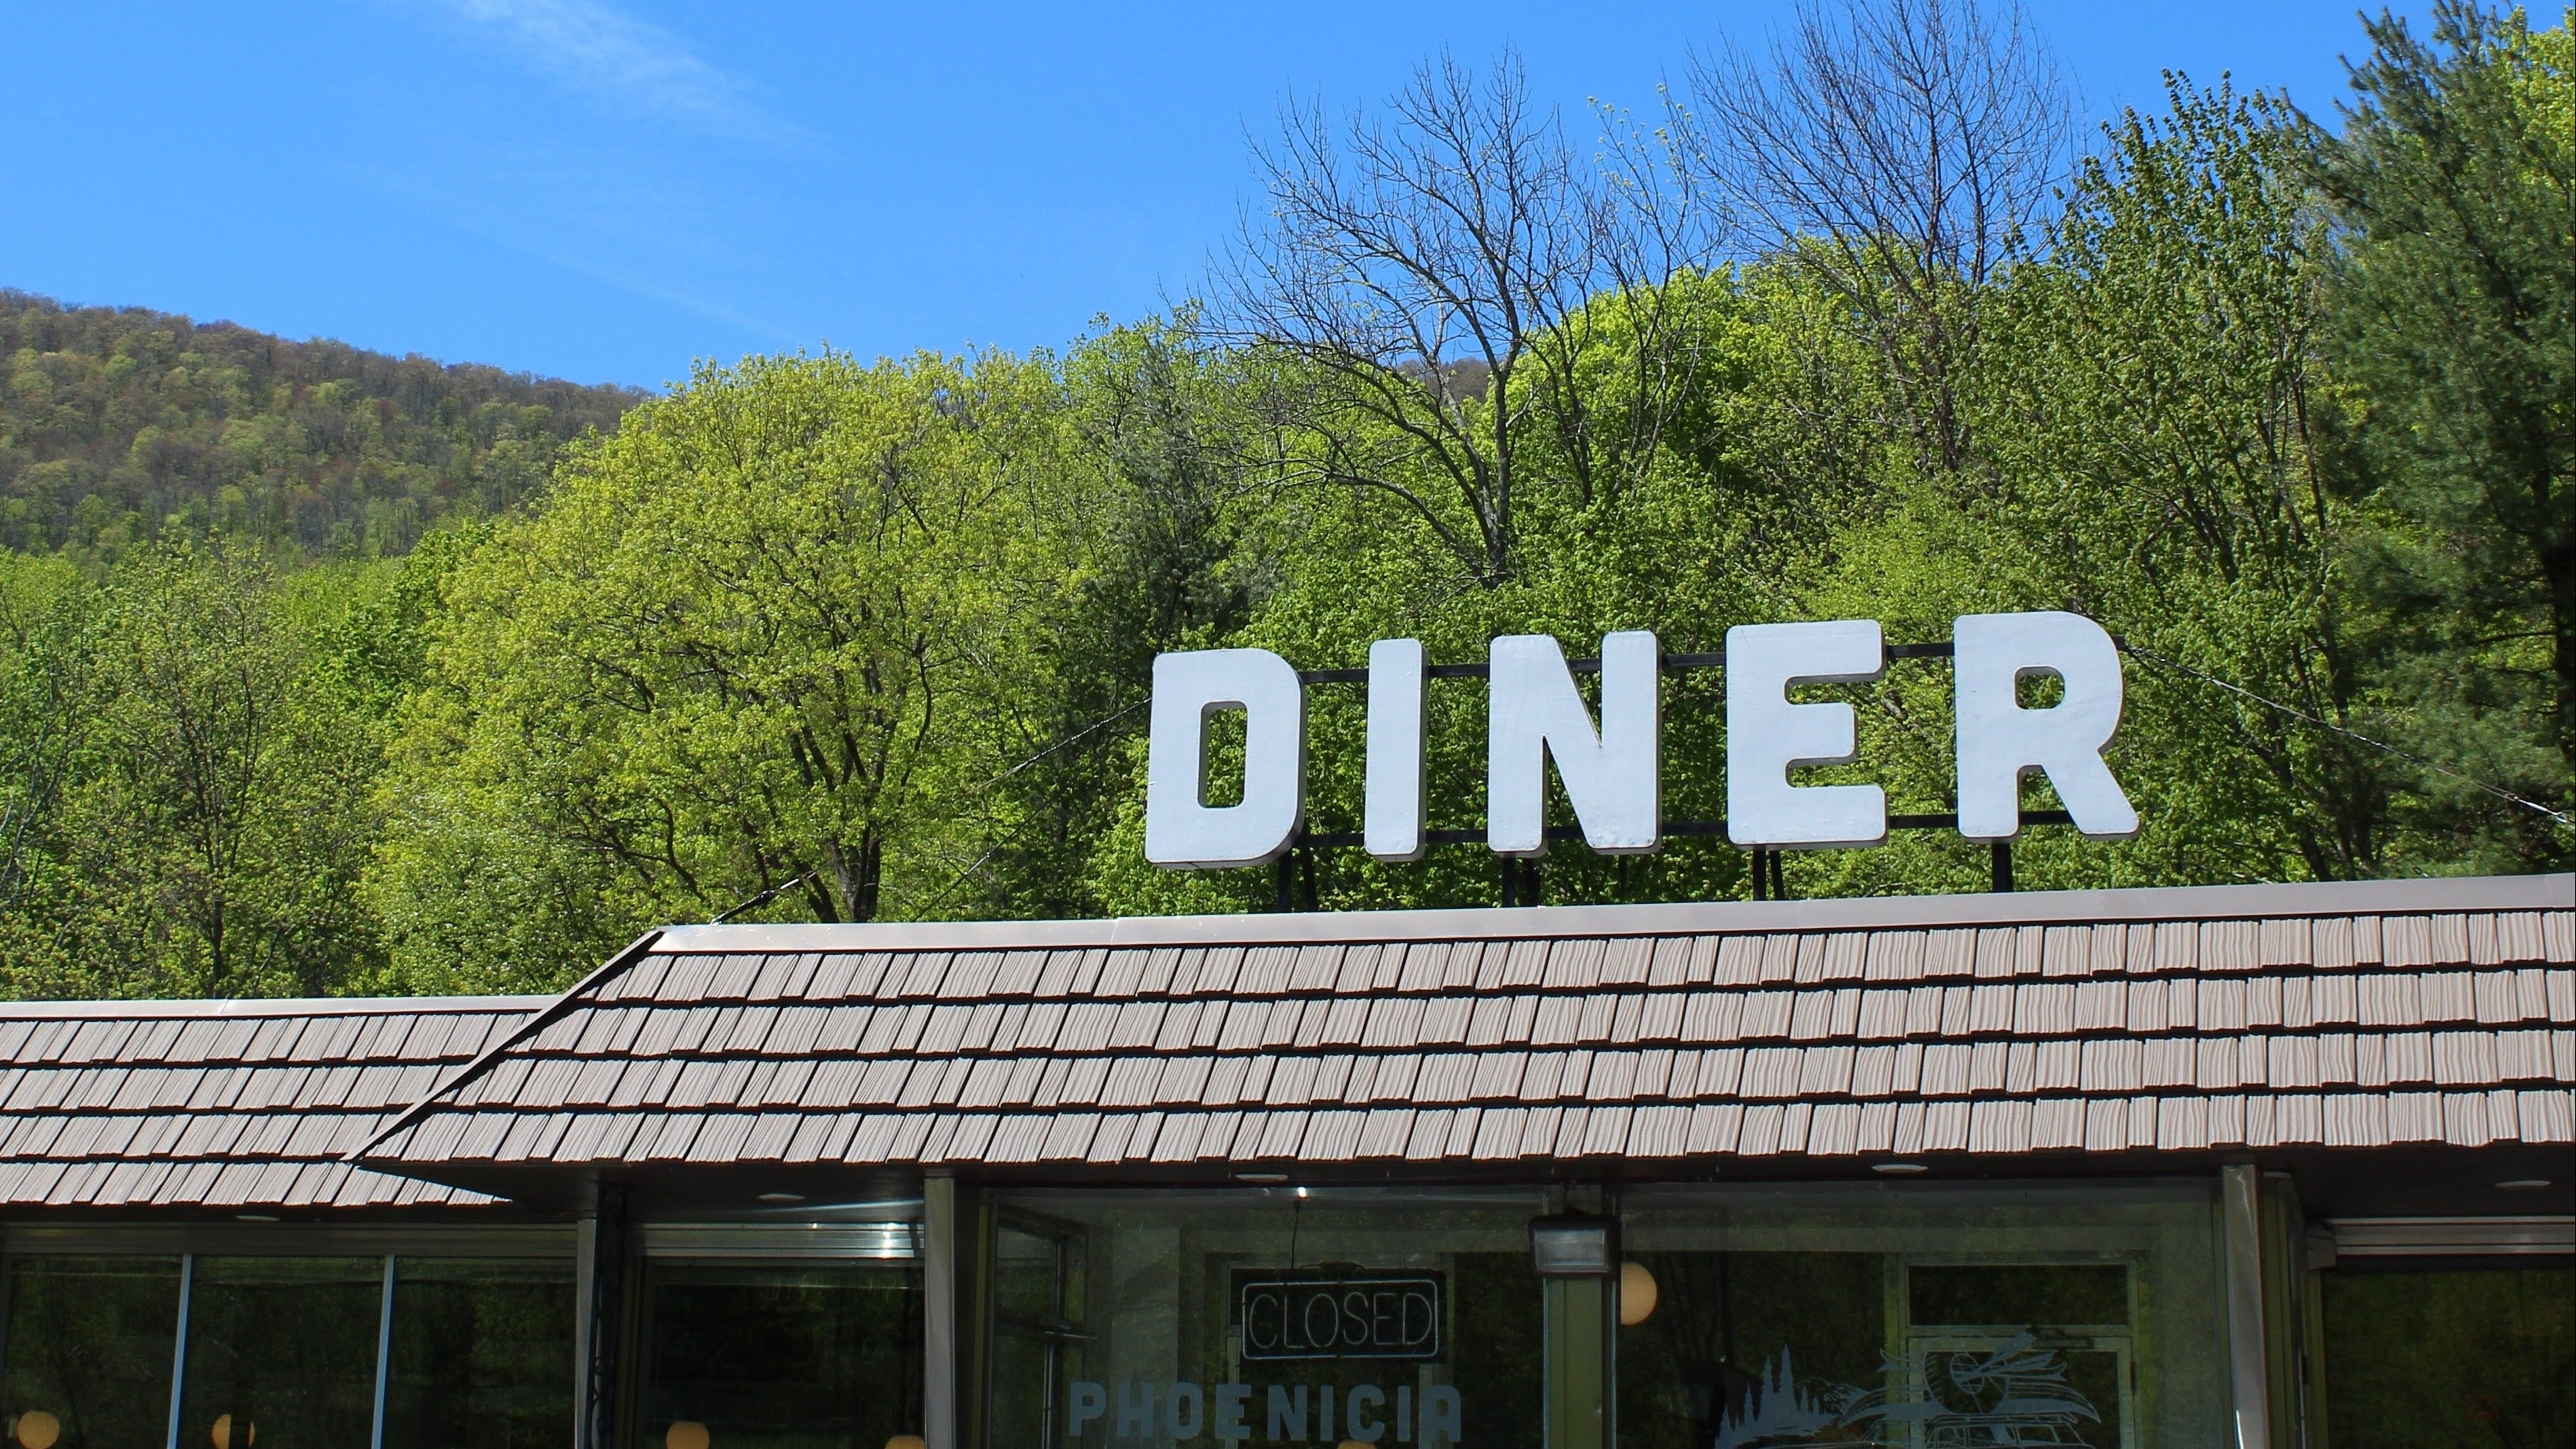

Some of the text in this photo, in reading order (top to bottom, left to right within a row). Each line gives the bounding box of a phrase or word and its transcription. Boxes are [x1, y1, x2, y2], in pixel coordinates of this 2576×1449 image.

[1145, 610, 2140, 867] DINER
[1249, 1293, 1433, 1349] CLOSED
[1069, 1381, 1461, 1443] PHOENICIA
